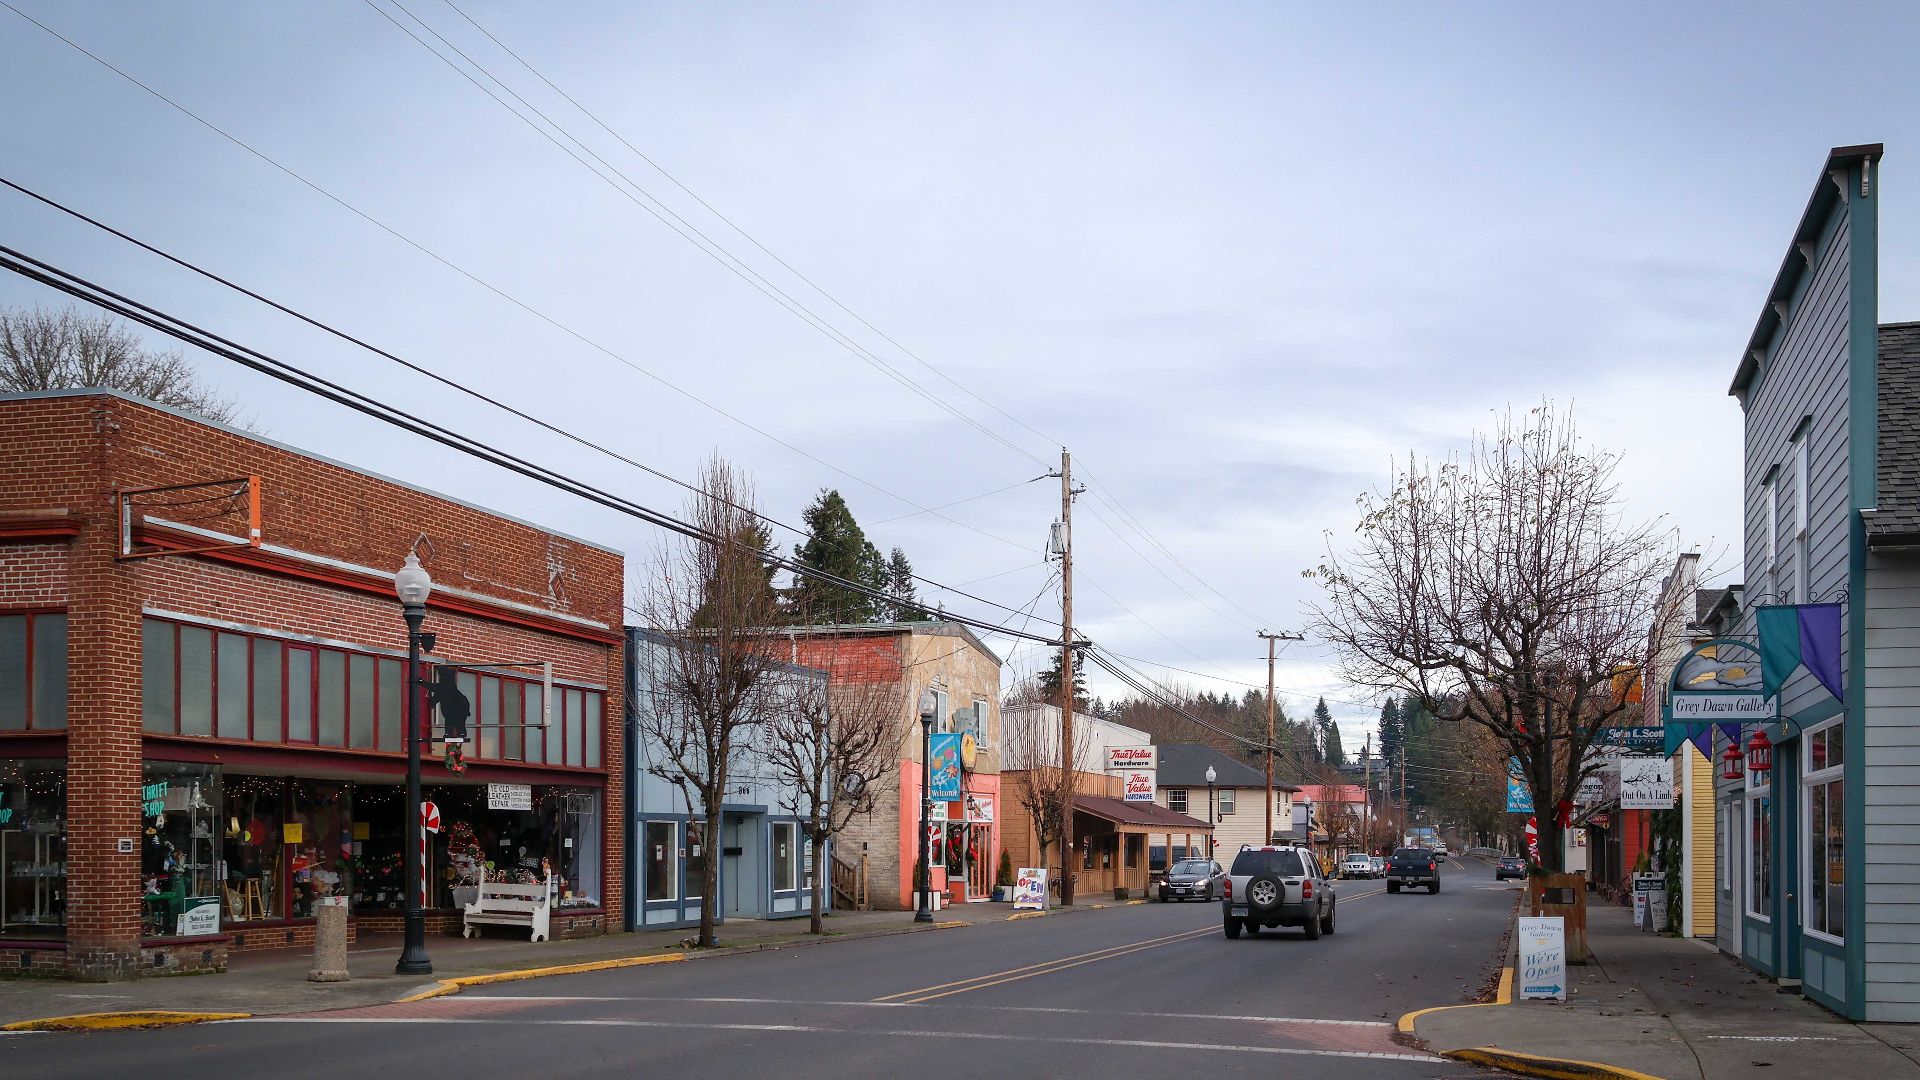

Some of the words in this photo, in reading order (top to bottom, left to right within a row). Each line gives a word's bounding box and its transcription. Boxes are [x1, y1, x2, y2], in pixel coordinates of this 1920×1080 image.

[1676, 698, 1699, 715] Grey
[1703, 698, 1733, 712] Dawn
[1736, 698, 1774, 715] Gallery
[1129, 773, 1149, 783] True
[142, 781, 168, 800] THRIFT
[931, 789, 958, 797] Welcome
[1126, 783, 1151, 793] Value
[1622, 789, 1634, 800] Out
[1636, 789, 1646, 800] On
[1648, 789, 1654, 800] A
[1655, 789, 1672, 800] Limb
[143, 801, 165, 818] SHOP
[1018, 877, 1043, 894] OPEN
[1521, 924, 1538, 932] Grey
[1541, 923, 1561, 931] Dawn
[1527, 952, 1559, 966] We're
[1525, 965, 1560, 979] Open
